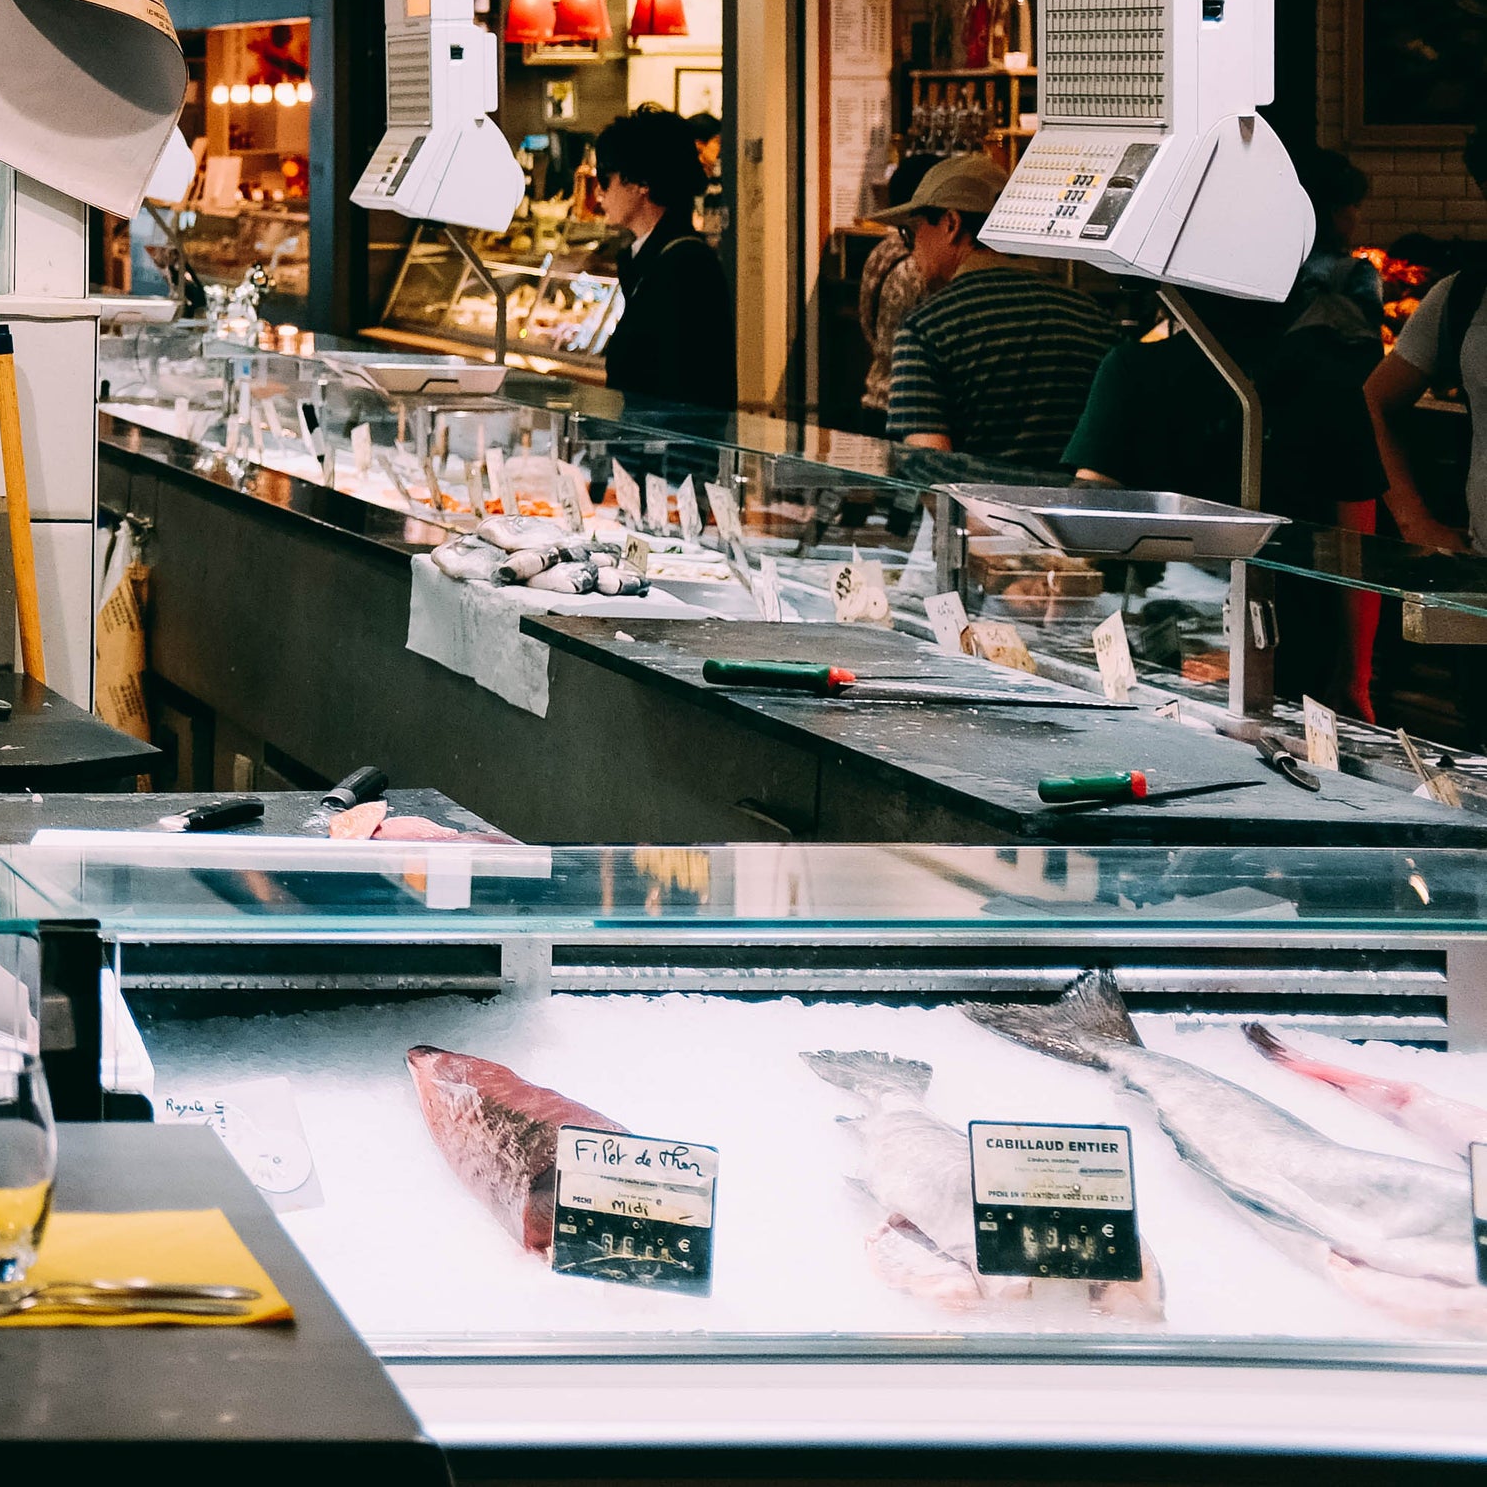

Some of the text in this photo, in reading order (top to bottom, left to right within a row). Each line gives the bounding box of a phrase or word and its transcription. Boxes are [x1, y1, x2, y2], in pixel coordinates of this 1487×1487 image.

[985, 1137, 1120, 1154] CABILLAUD ENTIER
[634, 1148, 652, 1168] de
